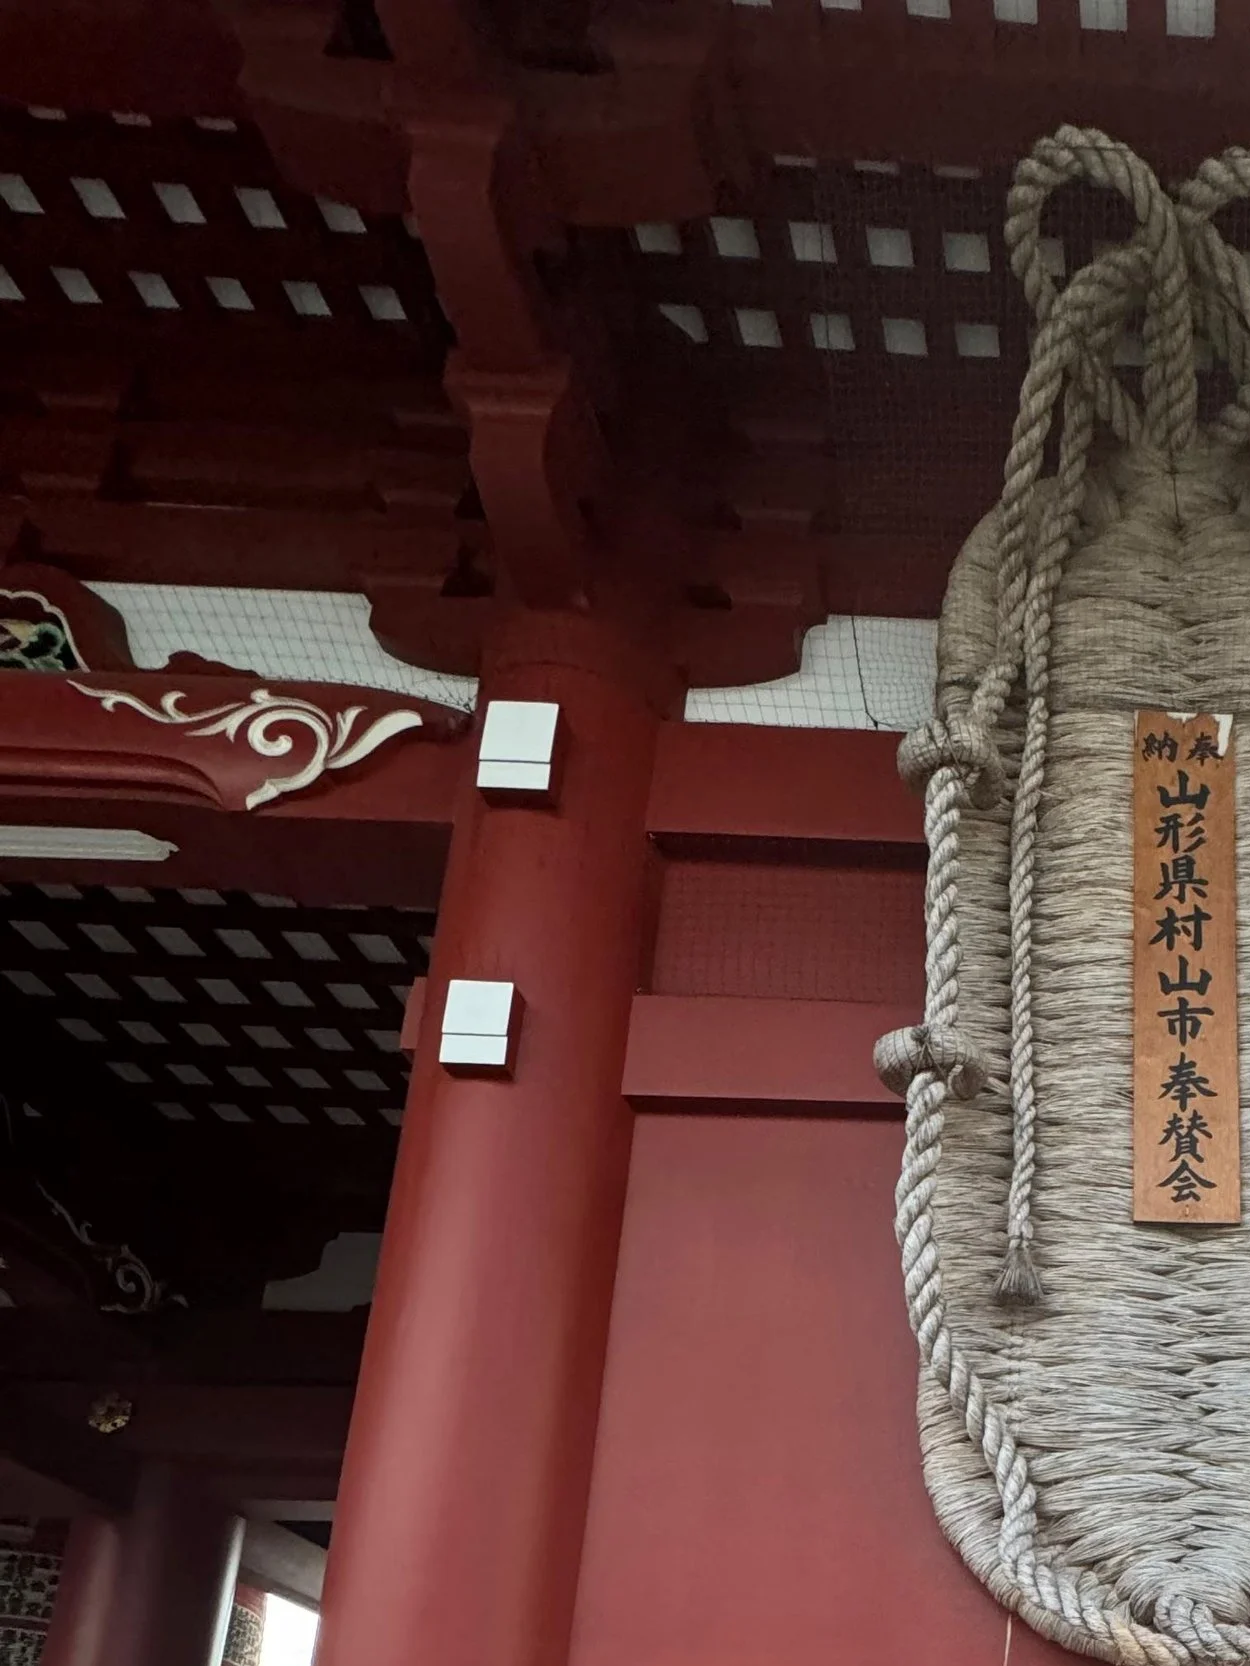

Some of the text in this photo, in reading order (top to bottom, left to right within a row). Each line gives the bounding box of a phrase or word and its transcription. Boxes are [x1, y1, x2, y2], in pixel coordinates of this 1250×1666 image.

[1148, 769, 1218, 1203] 山形県村山市奉賛会
